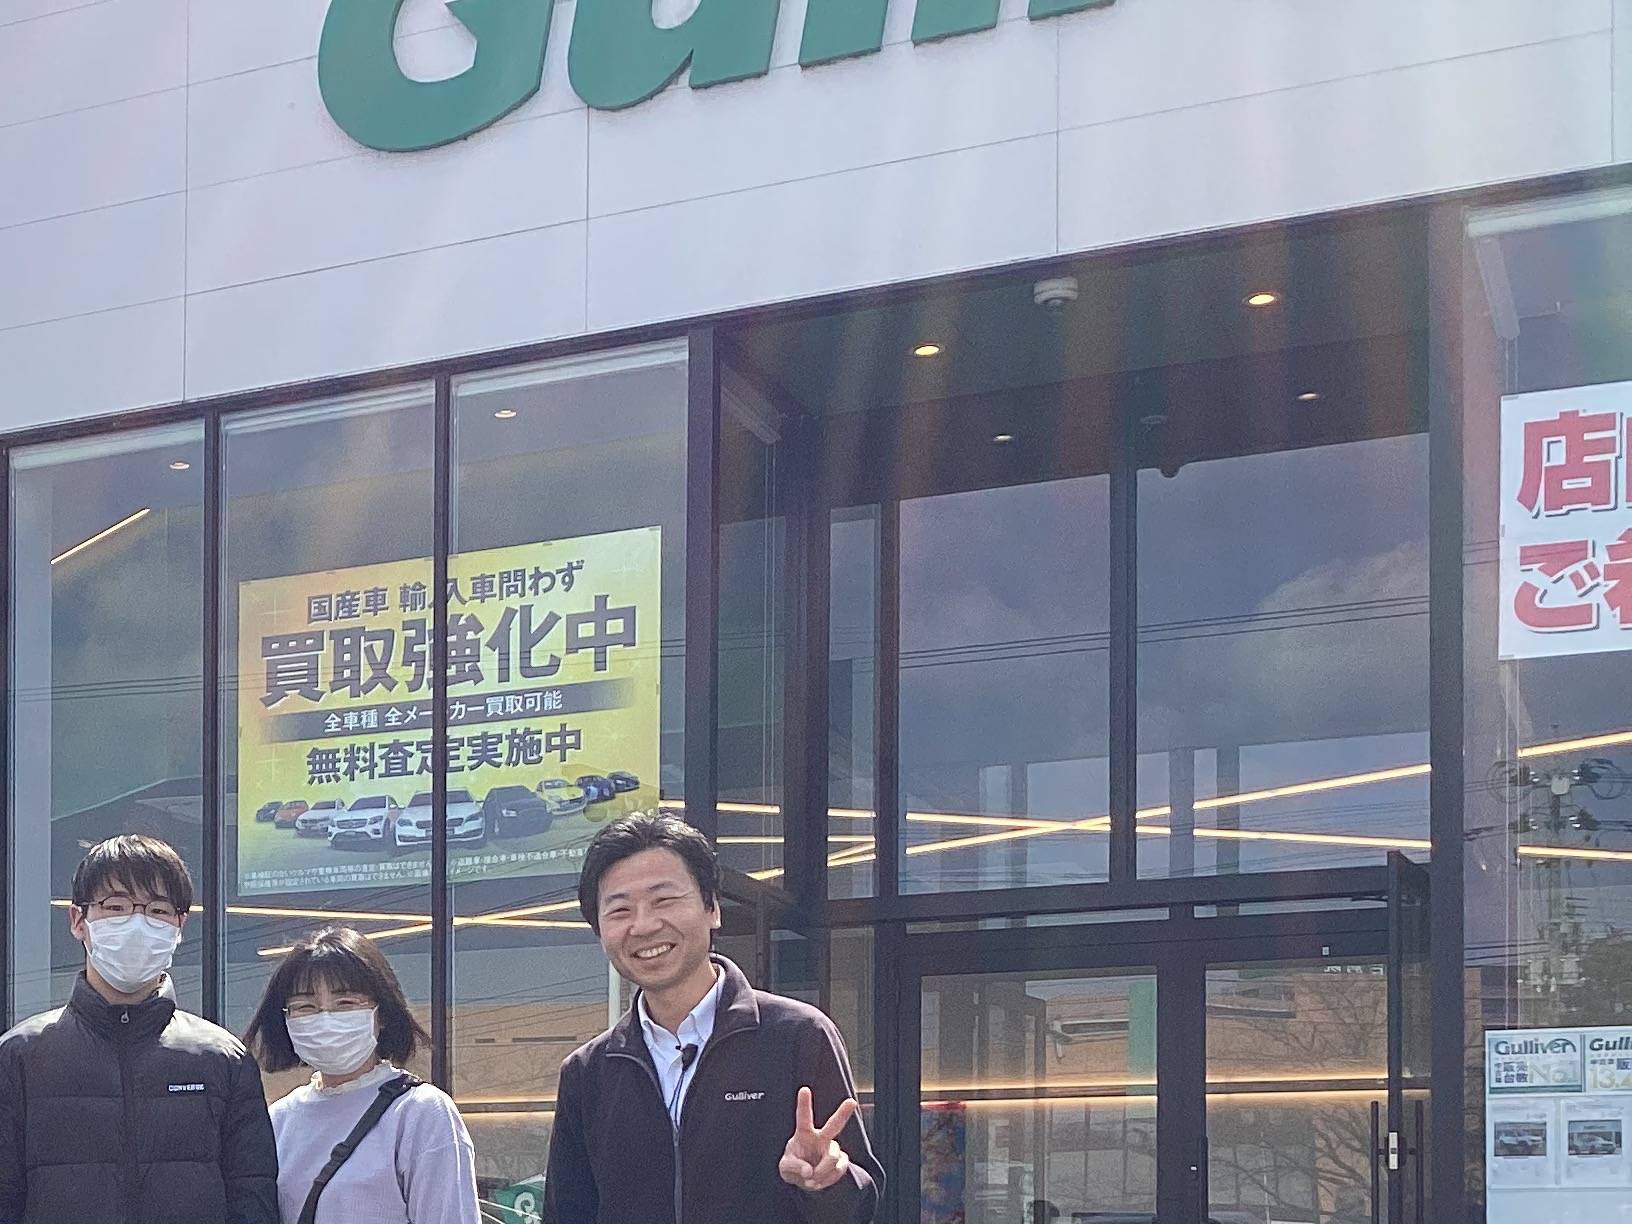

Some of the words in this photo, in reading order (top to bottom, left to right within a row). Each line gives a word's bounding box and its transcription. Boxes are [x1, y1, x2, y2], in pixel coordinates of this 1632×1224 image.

[307, 586, 389, 624] 国産車
[260, 594, 638, 707] 買取強化中
[306, 722, 583, 785] 無料査定実施中
[1494, 1037, 1576, 1055] Gulliver
[724, 1091, 765, 1101] Gulliver
